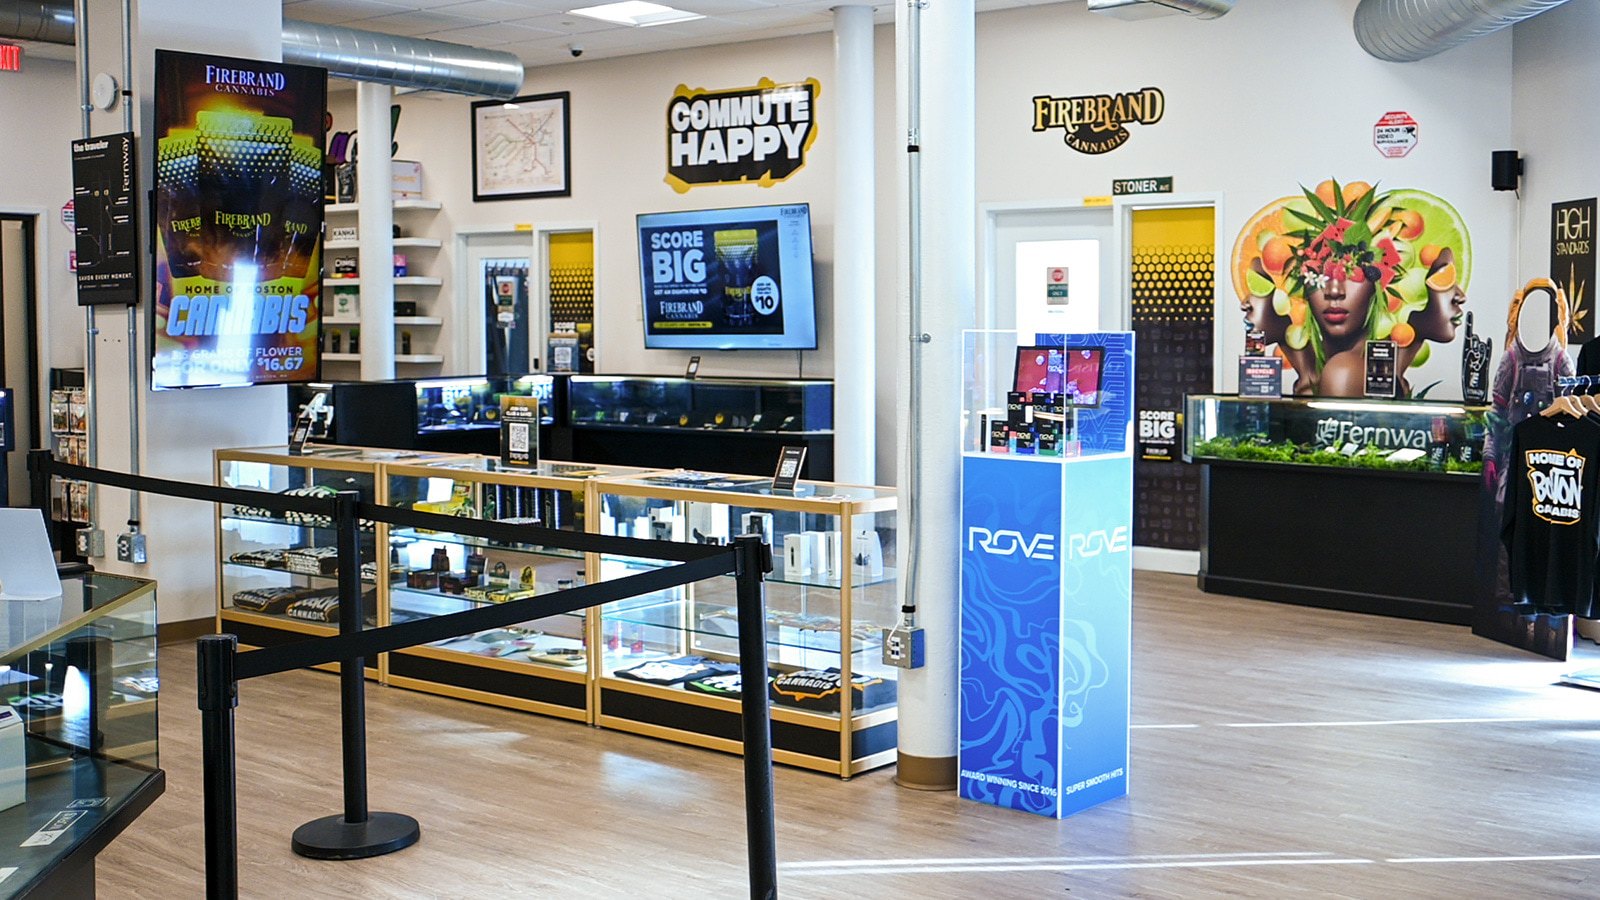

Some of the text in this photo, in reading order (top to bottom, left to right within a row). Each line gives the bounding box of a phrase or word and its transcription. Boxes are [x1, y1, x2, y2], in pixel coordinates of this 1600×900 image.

[206, 65, 285, 91] FIREBRAND
[215, 84, 275, 96] CANNABIS
[671, 90, 809, 132] COMMUTE
[1034, 89, 1163, 133] FIREBRAND
[671, 122, 808, 167] HAPPY
[1065, 130, 1128, 152] CANNABIS
[122, 137, 130, 192] Fernway
[1114, 180, 1157, 194] STONER
[215, 210, 272, 229] FIREBRAND
[1556, 206, 1591, 240] HIGH
[651, 230, 704, 249] SCORE
[1556, 240, 1590, 256] STANDARDS
[652, 249, 707, 283] BIG
[185, 286, 219, 294] HOME
[247, 285, 294, 294] OSTON
[660, 300, 704, 315] FIREBRAND
[755, 295, 774, 310] $10
[255, 346, 302, 358] FLOWER
[257, 357, 303, 371] $16.67
[1139, 410, 1175, 420] SCORE
[1139, 420, 1175, 439] BIG
[1528, 453, 1565, 466] HOME
[969, 526, 1055, 560] ROVE
[1069, 525, 1127, 560] ROVE
[961, 769, 1057, 797] AWARD WINNING SINCE 2016
[1065, 767, 1124, 795] SUPER SMOOTH HITS
